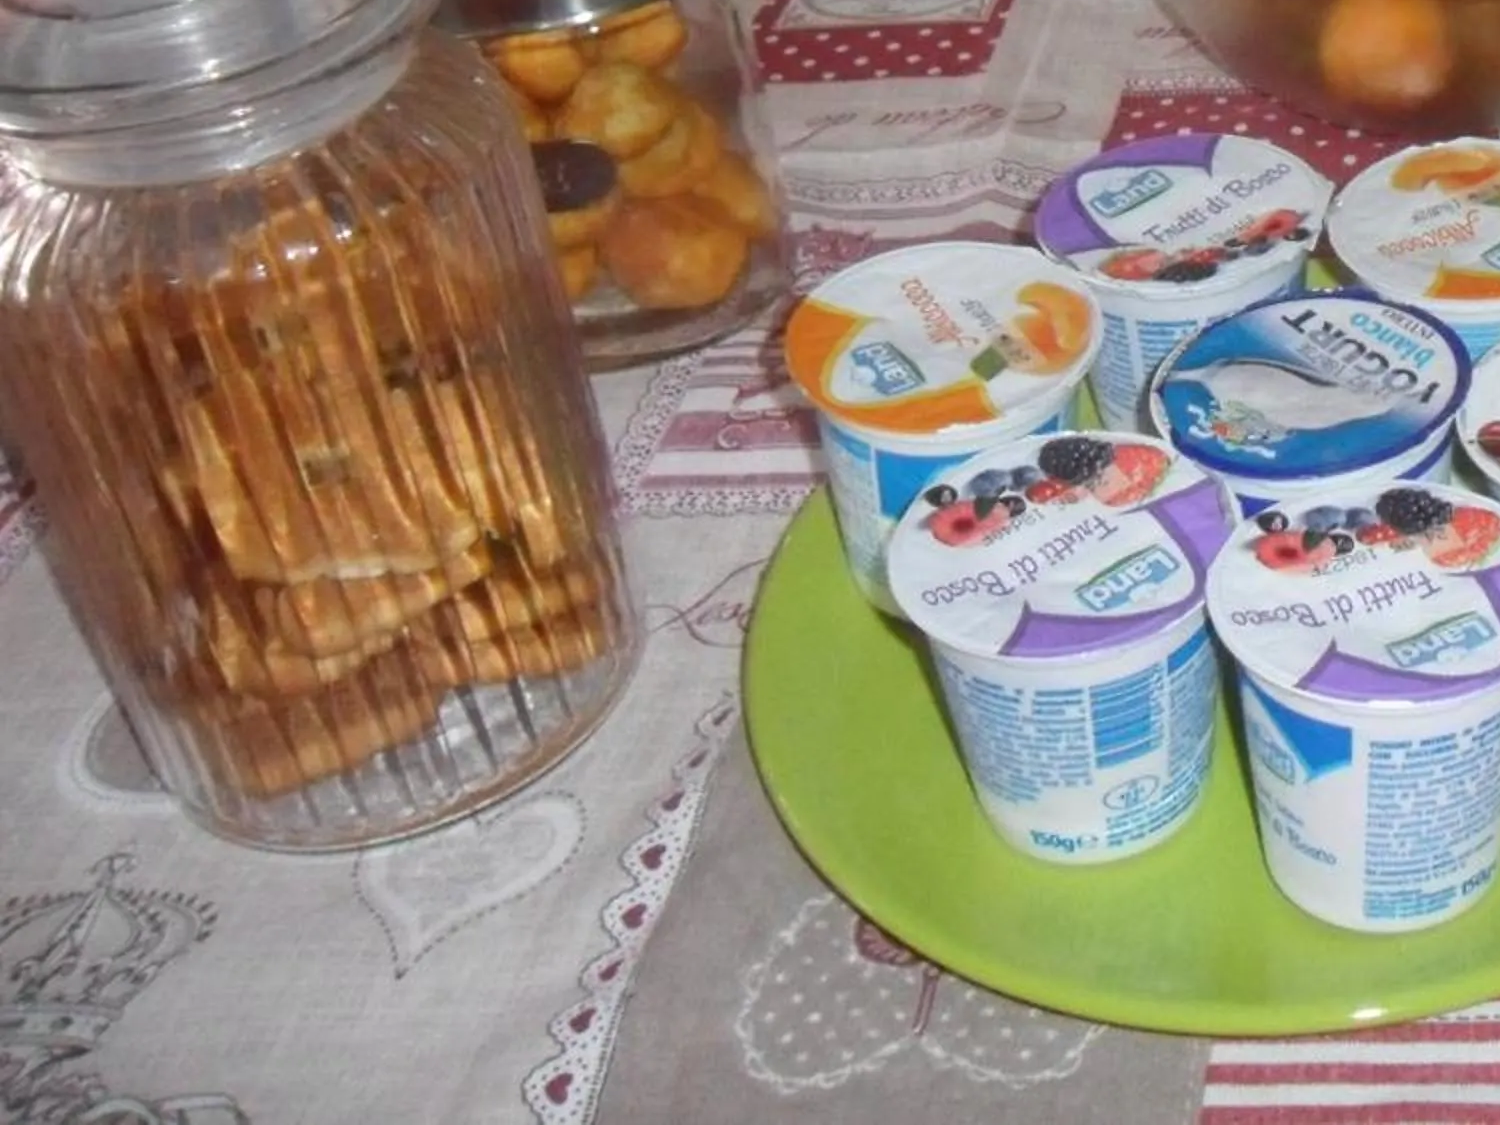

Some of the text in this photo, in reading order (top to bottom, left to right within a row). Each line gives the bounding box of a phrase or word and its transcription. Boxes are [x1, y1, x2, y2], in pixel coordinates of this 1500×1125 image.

[1092, 172, 1166, 213] Land
[1141, 211, 1202, 244] Frutti
[1204, 191, 1227, 217] di
[1223, 162, 1291, 199] Bosco
[1281, 308, 1441, 404] YOGURT
[1350, 312, 1436, 367] bianco
[860, 345, 918, 390] Land
[1043, 513, 1119, 563] Frutti
[922, 570, 1016, 606] Bosco
[1008, 554, 1036, 584] di
[1088, 550, 1177, 608] Land
[1232, 568, 1442, 628] Frutti di Bosco
[1397, 613, 1495, 666] Land
